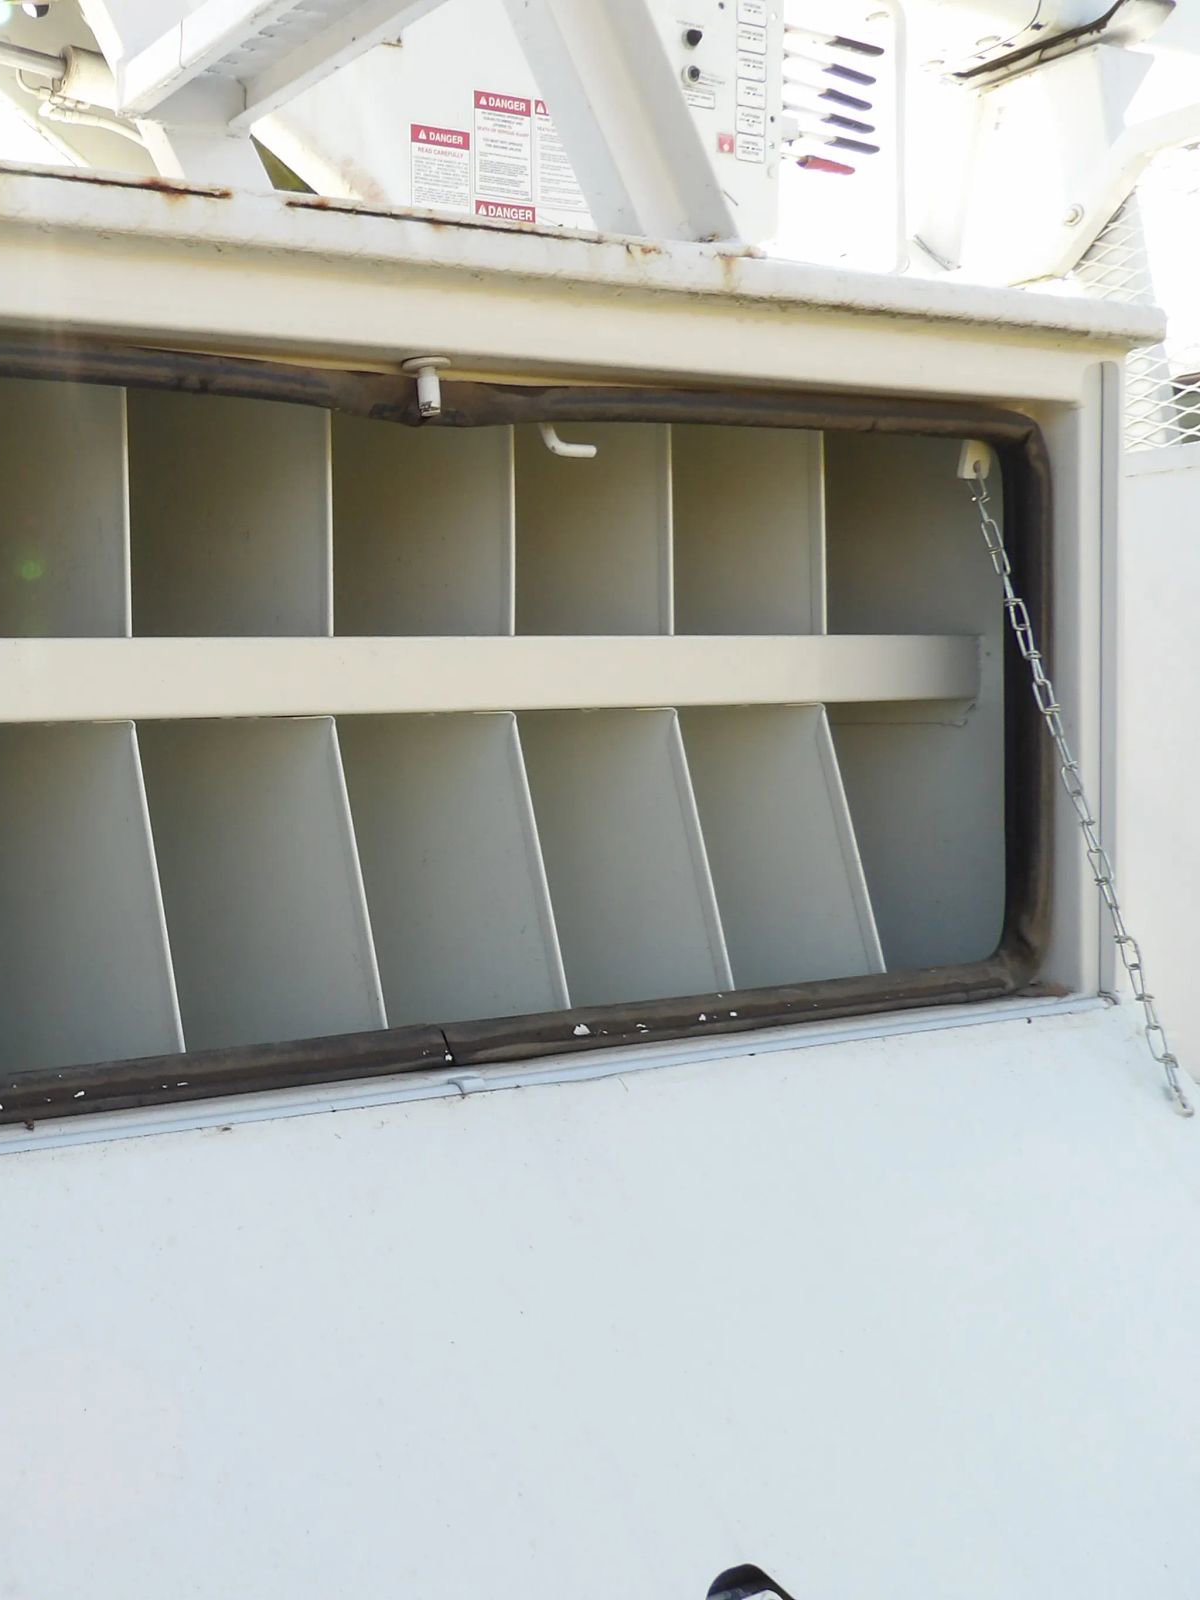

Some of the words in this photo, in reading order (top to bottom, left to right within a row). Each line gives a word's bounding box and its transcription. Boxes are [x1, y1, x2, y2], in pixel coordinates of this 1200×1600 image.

[488, 96, 526, 113] DANGER
[429, 131, 463, 145] DANGER
[488, 205, 533, 221] DANGER
